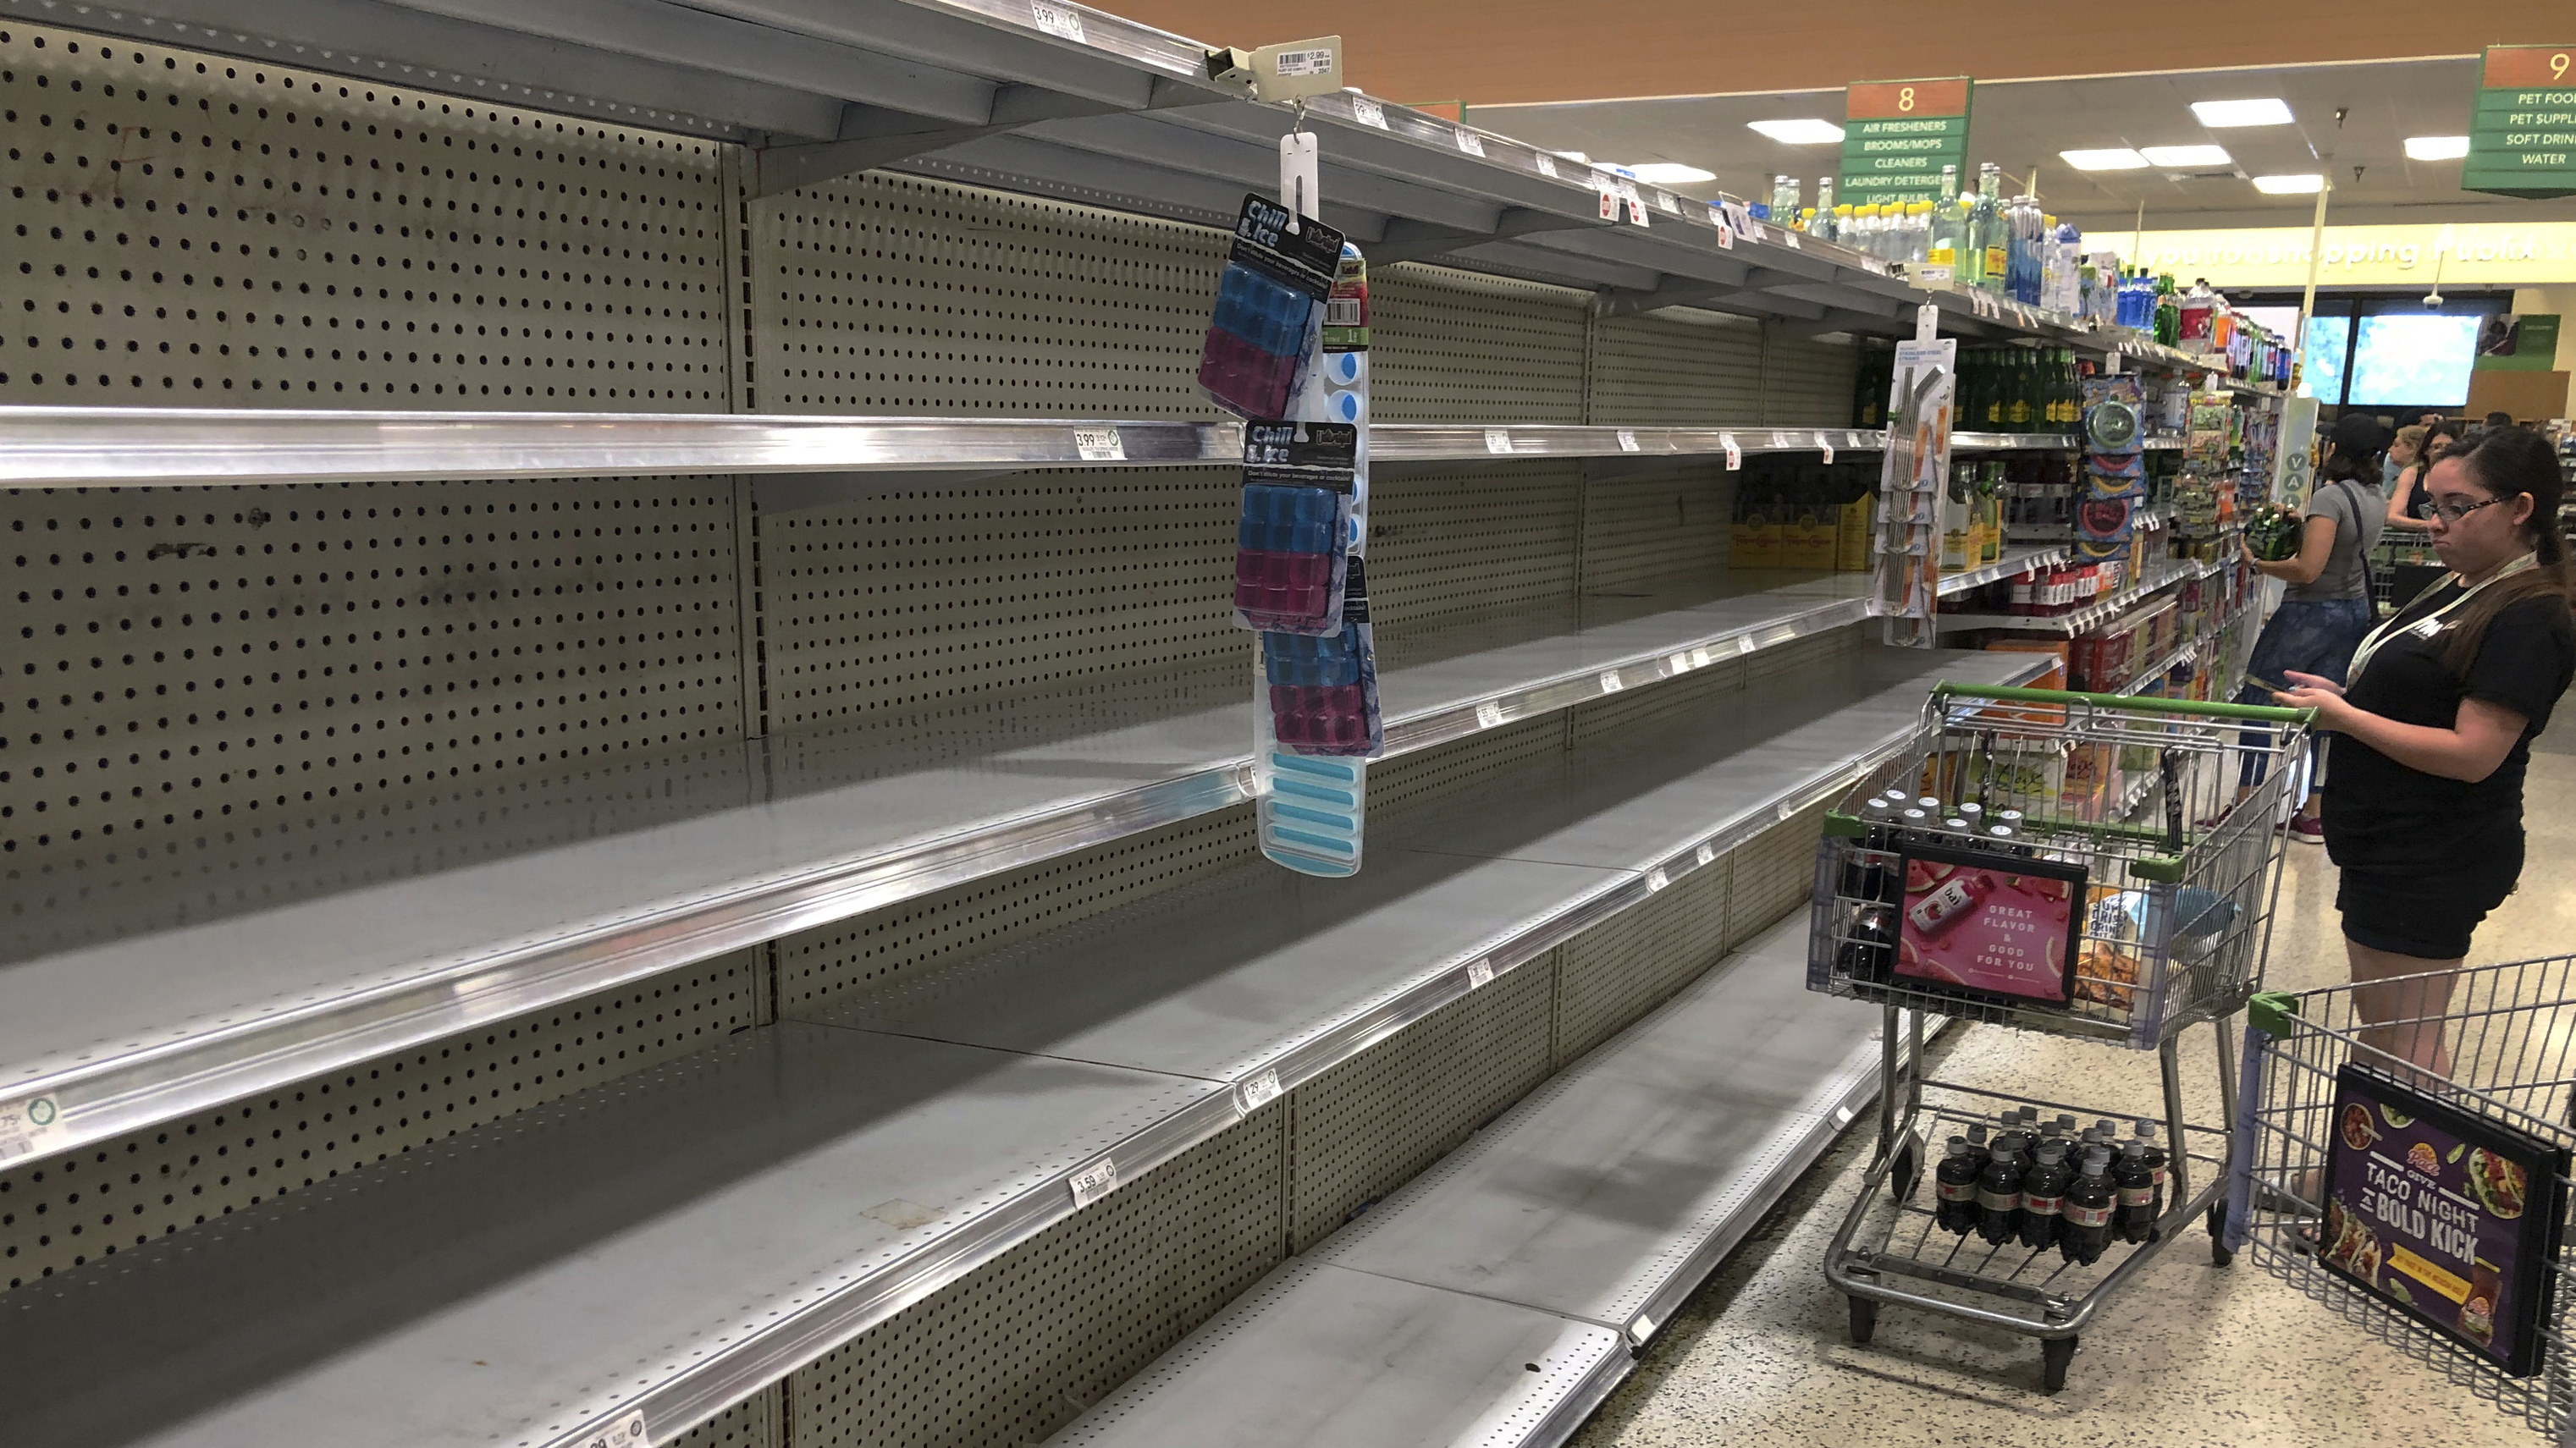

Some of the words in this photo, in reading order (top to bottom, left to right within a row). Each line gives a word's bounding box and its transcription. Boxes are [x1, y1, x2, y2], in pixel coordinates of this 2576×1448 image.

[2550, 52, 2570, 80] 9
[1898, 87, 1915, 112] 8
[2518, 93, 2542, 105] PET
[2509, 113, 2534, 125] PET
[1862, 123, 1880, 134] AIR
[1882, 121, 1947, 133] FRESHENERS
[1864, 139, 1942, 151] BROOMS/MOPS
[2506, 134, 2540, 146] SOFT
[1874, 157, 1928, 168] CLEANERS
[2522, 153, 2567, 165] WATER
[1845, 176, 1893, 187] LAUNDRY
[1895, 174, 1943, 186] DETERGE
[1866, 194, 1896, 204] LIGHT
[1247, 200, 1289, 232] Chill
[1253, 223, 1279, 247] Ice
[1251, 426, 1294, 445] Chill
[1262, 444, 1289, 463] Ice
[1989, 905, 2033, 919] GREAT
[1983, 917, 2034, 933] FLAVOR
[2003, 933, 2011, 943] &
[1989, 944, 2024, 957] GOOD
[1977, 955, 2002, 966] FOR
[2008, 959, 2034, 972] YOU
[2367, 1162, 2411, 1201] TACO
[2418, 1189, 2479, 1233] NIGHT
[2376, 1192, 2427, 1241] BOLD
[2430, 1219, 2479, 1266] KICK
